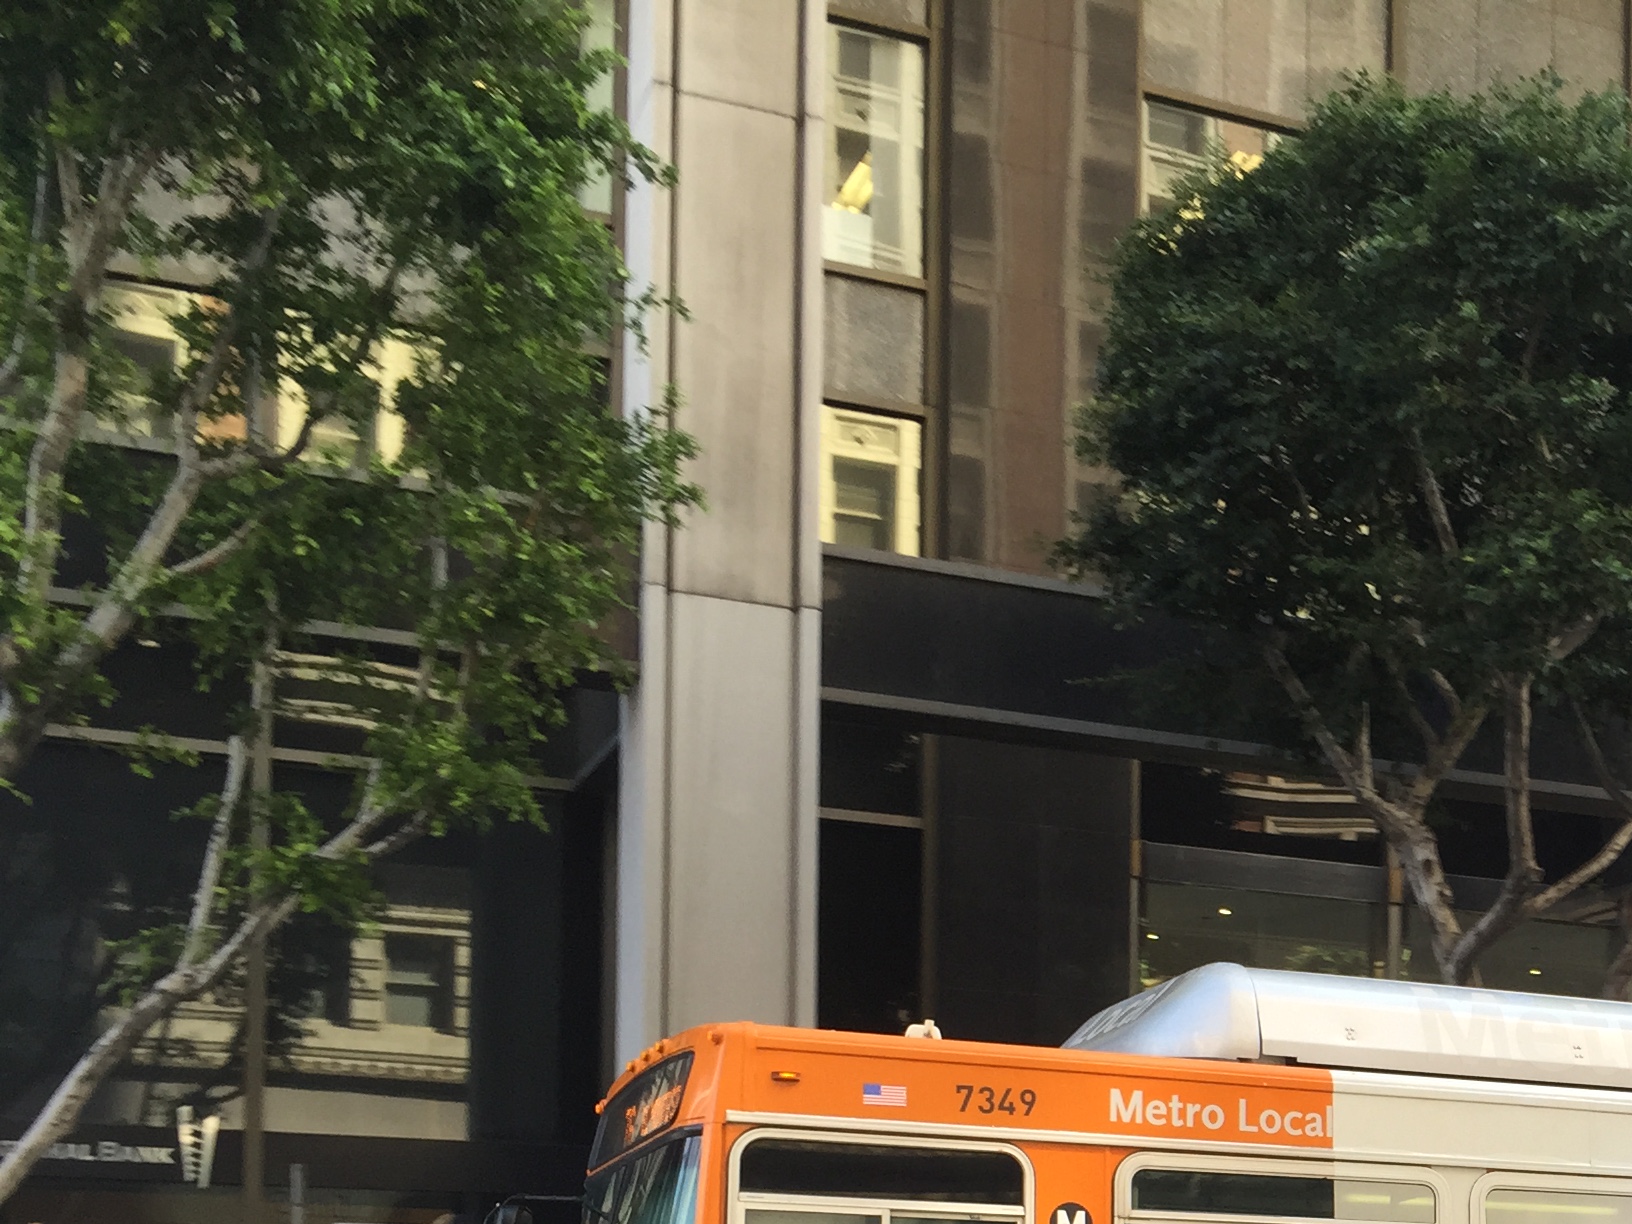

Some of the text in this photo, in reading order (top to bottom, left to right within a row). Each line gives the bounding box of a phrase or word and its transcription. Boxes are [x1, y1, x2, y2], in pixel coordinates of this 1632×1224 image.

[955, 1084, 1037, 1117] 7349
[1109, 1088, 1333, 1139] Metro Local
